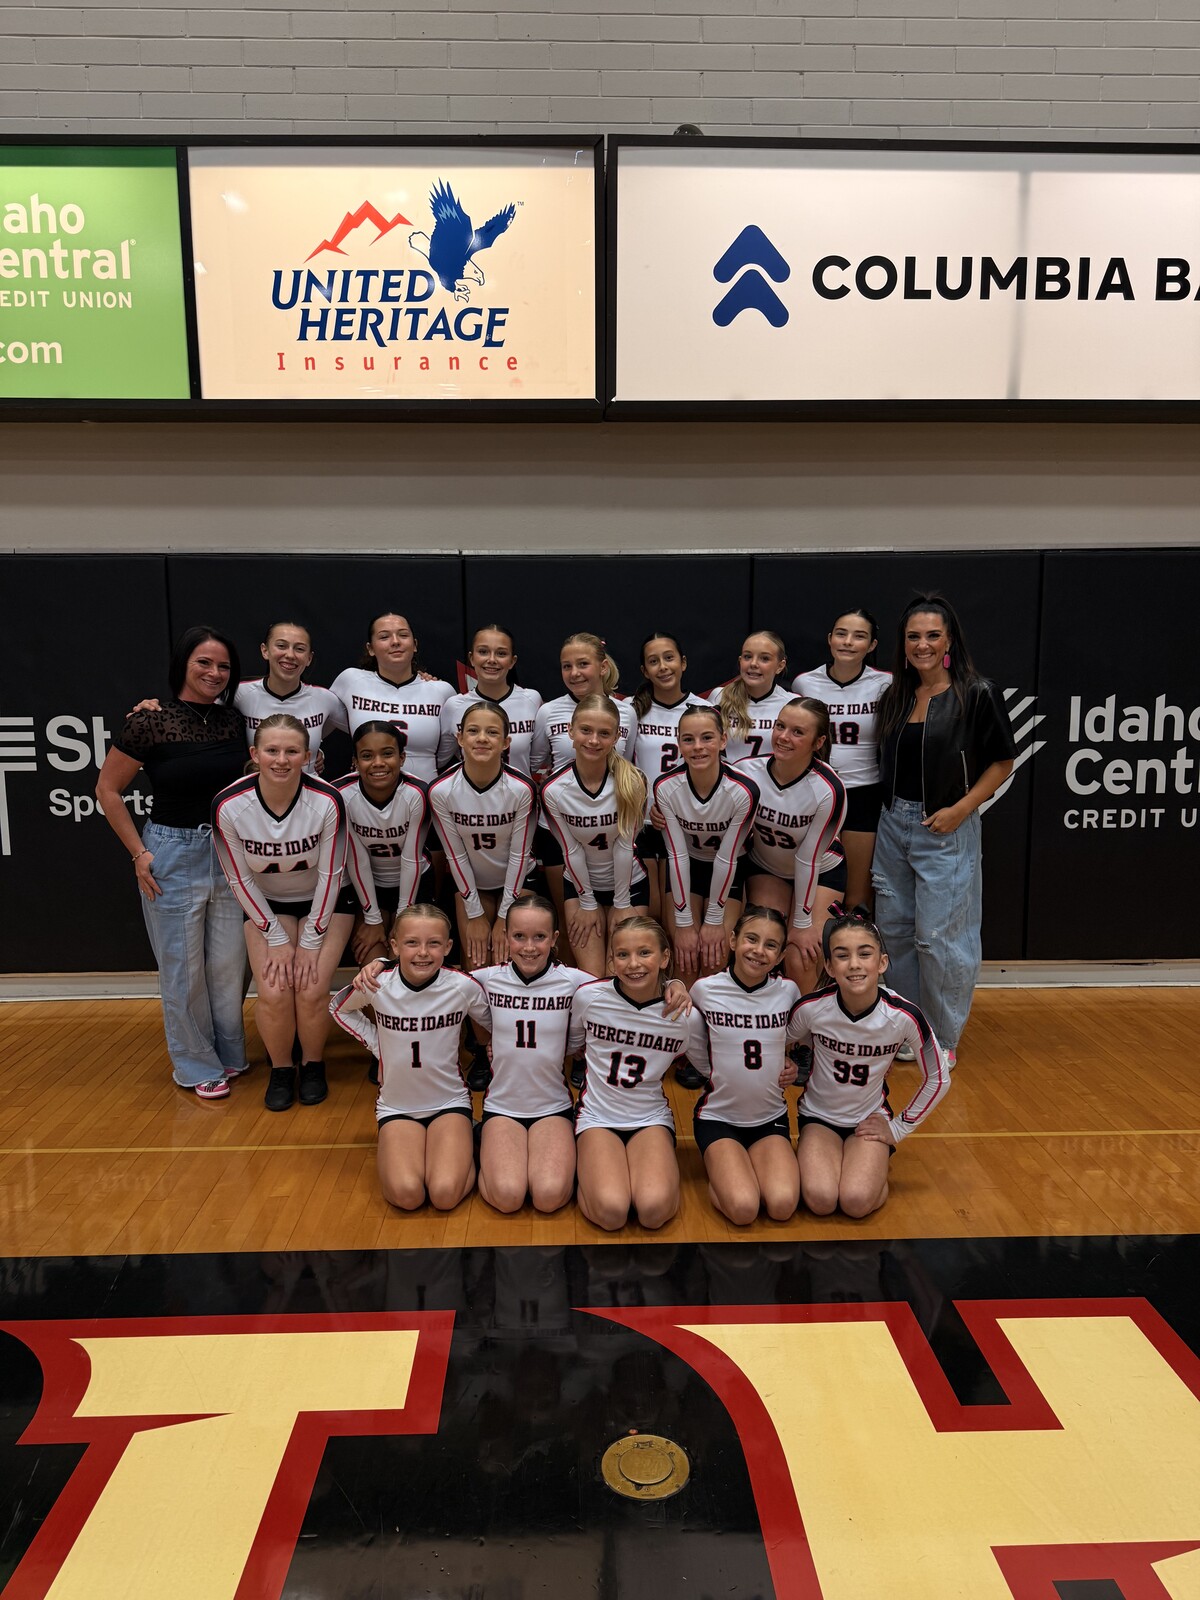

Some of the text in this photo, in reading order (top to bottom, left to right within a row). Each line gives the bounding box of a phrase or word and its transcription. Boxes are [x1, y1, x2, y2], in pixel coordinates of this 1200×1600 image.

[272, 269, 436, 310] UNITED
[812, 255, 1135, 300] COLUMBIA
[63, 291, 132, 308] UNION
[297, 307, 509, 348] HERITAGE
[277, 352, 518, 371] Insurance
[352, 695, 441, 717] FIERCE IDAHO
[660, 743, 679, 773] 2
[744, 735, 764, 757] 7
[1065, 746, 1200, 795] Cent
[1063, 808, 1166, 829] CREDIT
[471, 832, 497, 851] 15
[587, 832, 609, 851] 4
[689, 833, 722, 851] 14
[754, 821, 798, 850] 53
[367, 842, 403, 858] 21
[488, 992, 573, 1011] FIERCE IDAHO
[376, 1010, 463, 1033] FIERCE IDAHO
[515, 1019, 537, 1049] 11
[586, 1020, 684, 1054] FIERCE IDAHO
[411, 1041, 422, 1069] 1
[743, 1039, 763, 1071] 8
[606, 1050, 648, 1089] 13
[833, 1059, 870, 1087] 99
